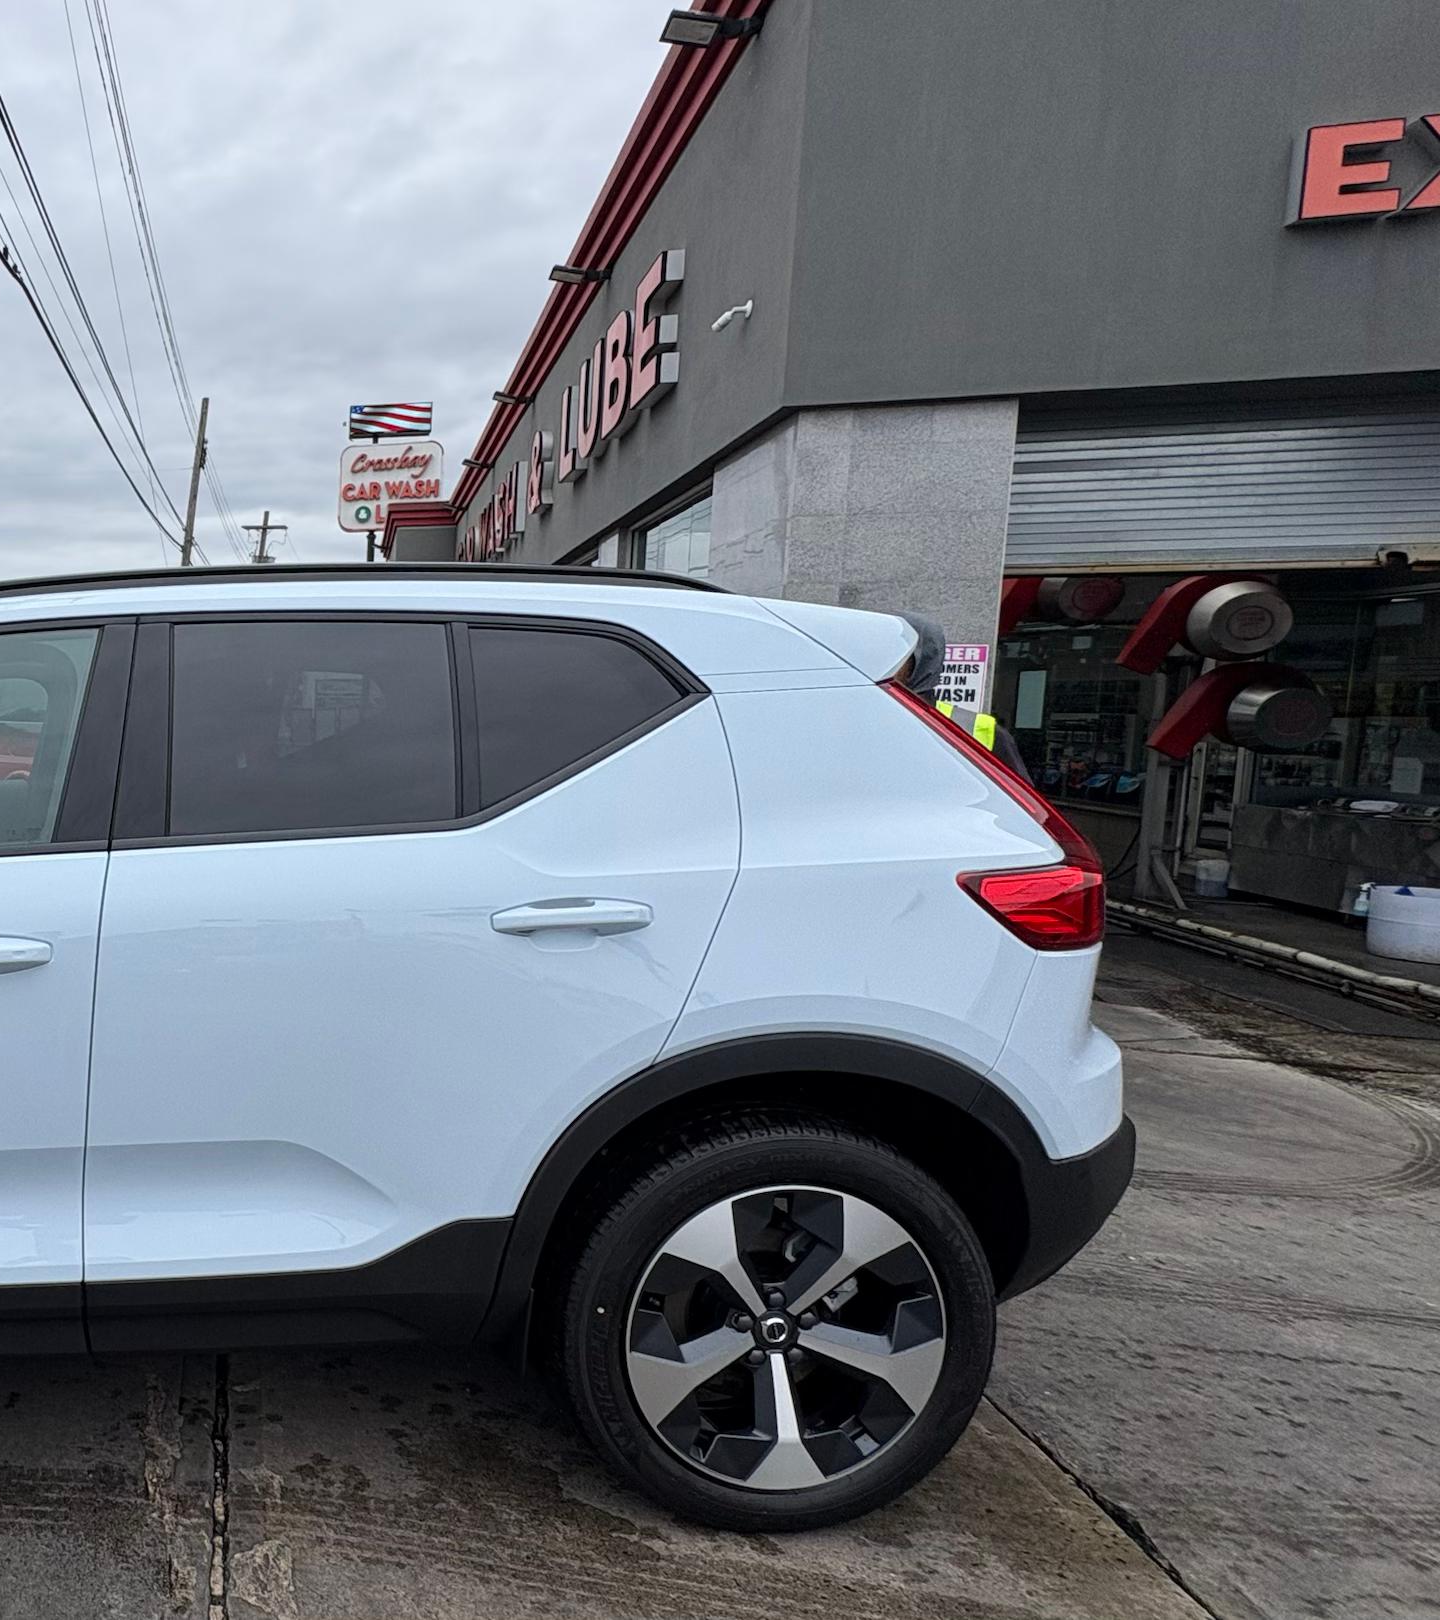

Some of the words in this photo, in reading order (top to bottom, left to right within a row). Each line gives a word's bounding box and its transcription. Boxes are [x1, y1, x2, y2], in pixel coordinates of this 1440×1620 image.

[559, 250, 670, 484] LUBE
[342, 481, 381, 501] CAR
[385, 479, 440, 499] WASH
[954, 676, 967, 685] IN
